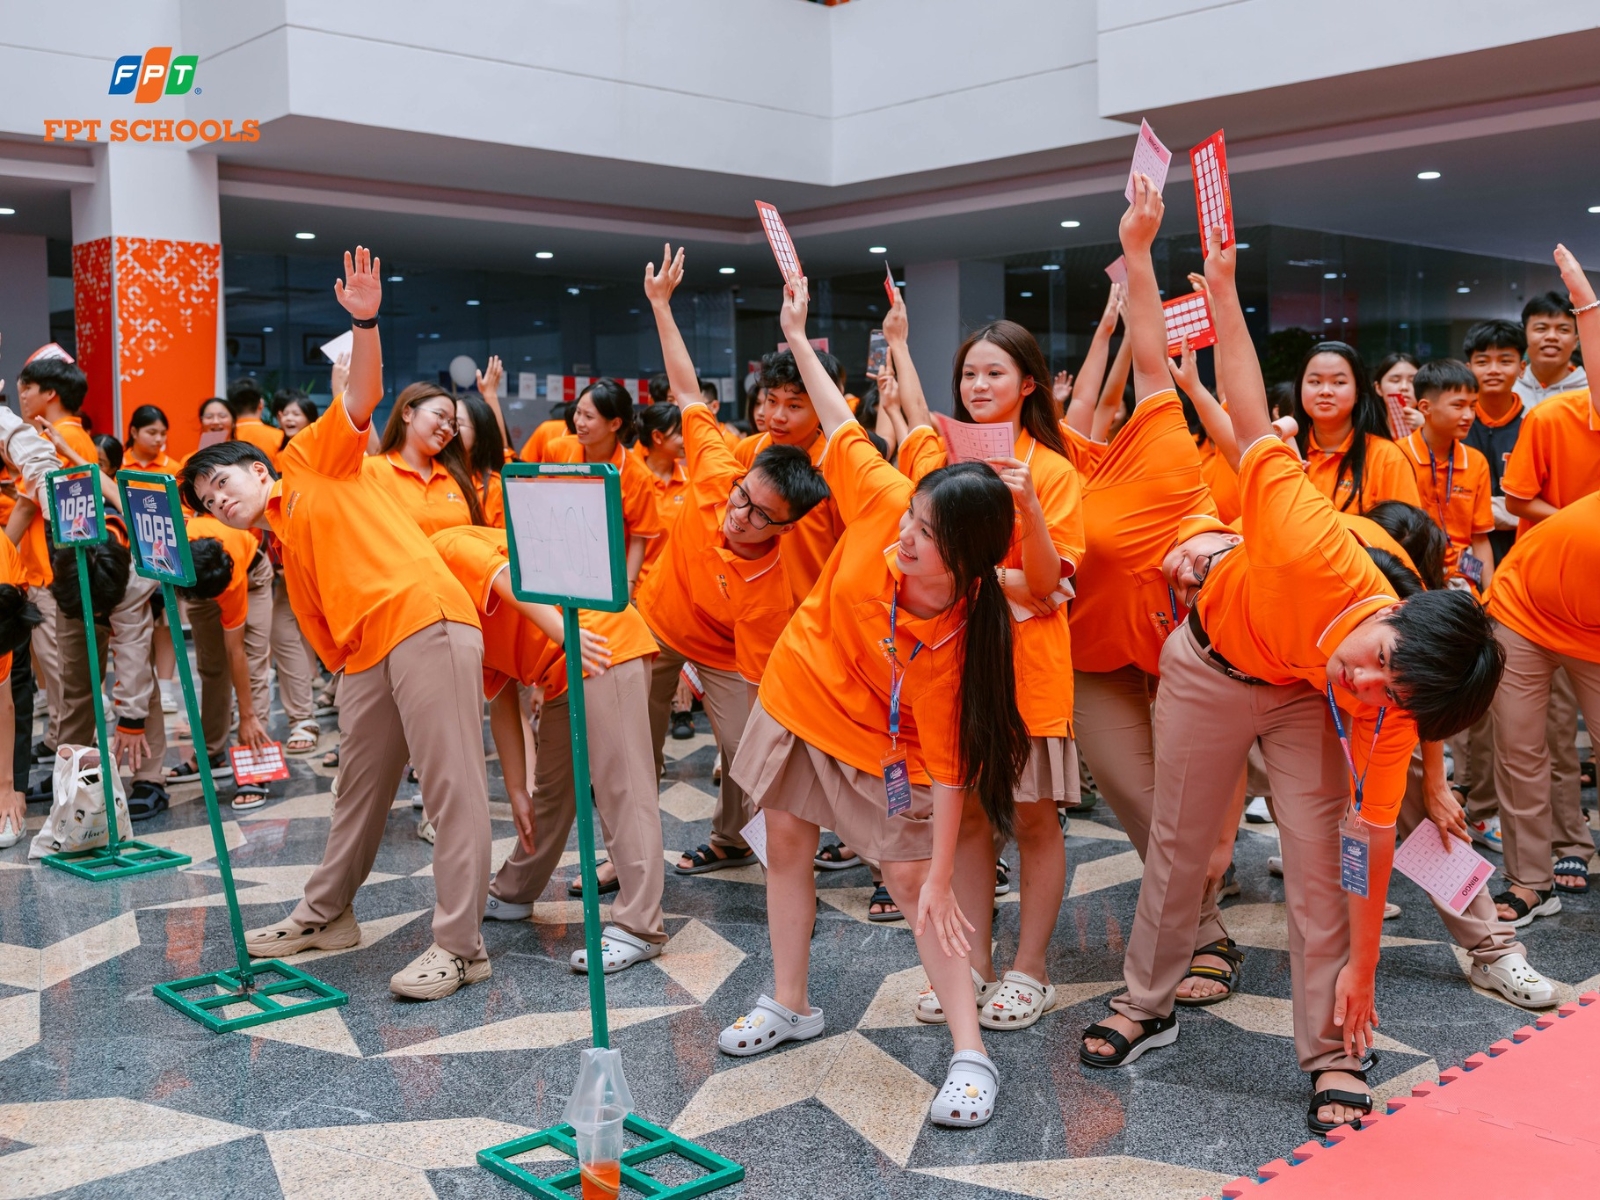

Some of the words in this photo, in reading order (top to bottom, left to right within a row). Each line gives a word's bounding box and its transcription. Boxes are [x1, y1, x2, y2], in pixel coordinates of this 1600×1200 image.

[60, 494, 96, 521] 10A2
[135, 512, 177, 548] 10A3
[1461, 875, 1480, 897] BINGO
